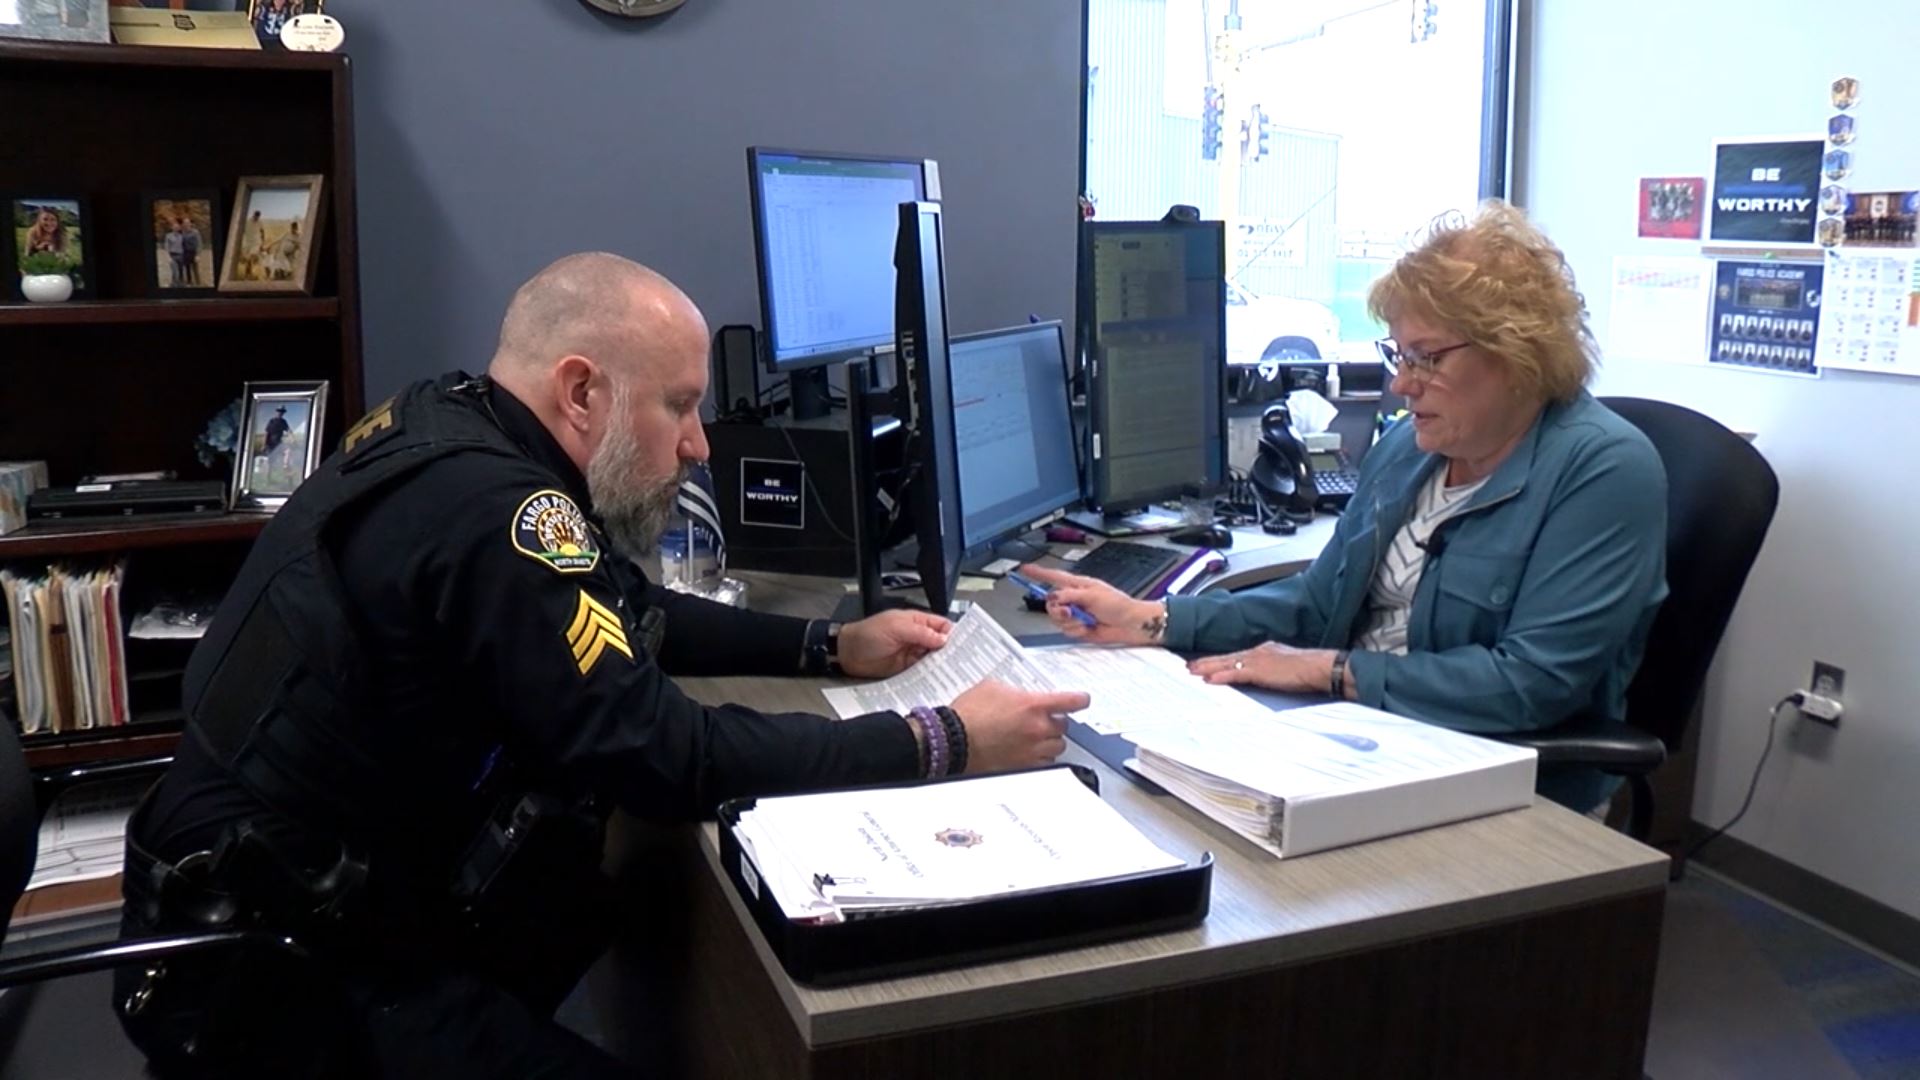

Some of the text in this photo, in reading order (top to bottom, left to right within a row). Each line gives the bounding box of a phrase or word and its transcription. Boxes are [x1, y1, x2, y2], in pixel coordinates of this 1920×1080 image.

[1751, 167, 1781, 181] BE
[1717, 198, 1811, 212] WORTHY
[764, 479, 780, 487] BE
[746, 492, 798, 502] WORTHY
[521, 496, 551, 531] FARGO
